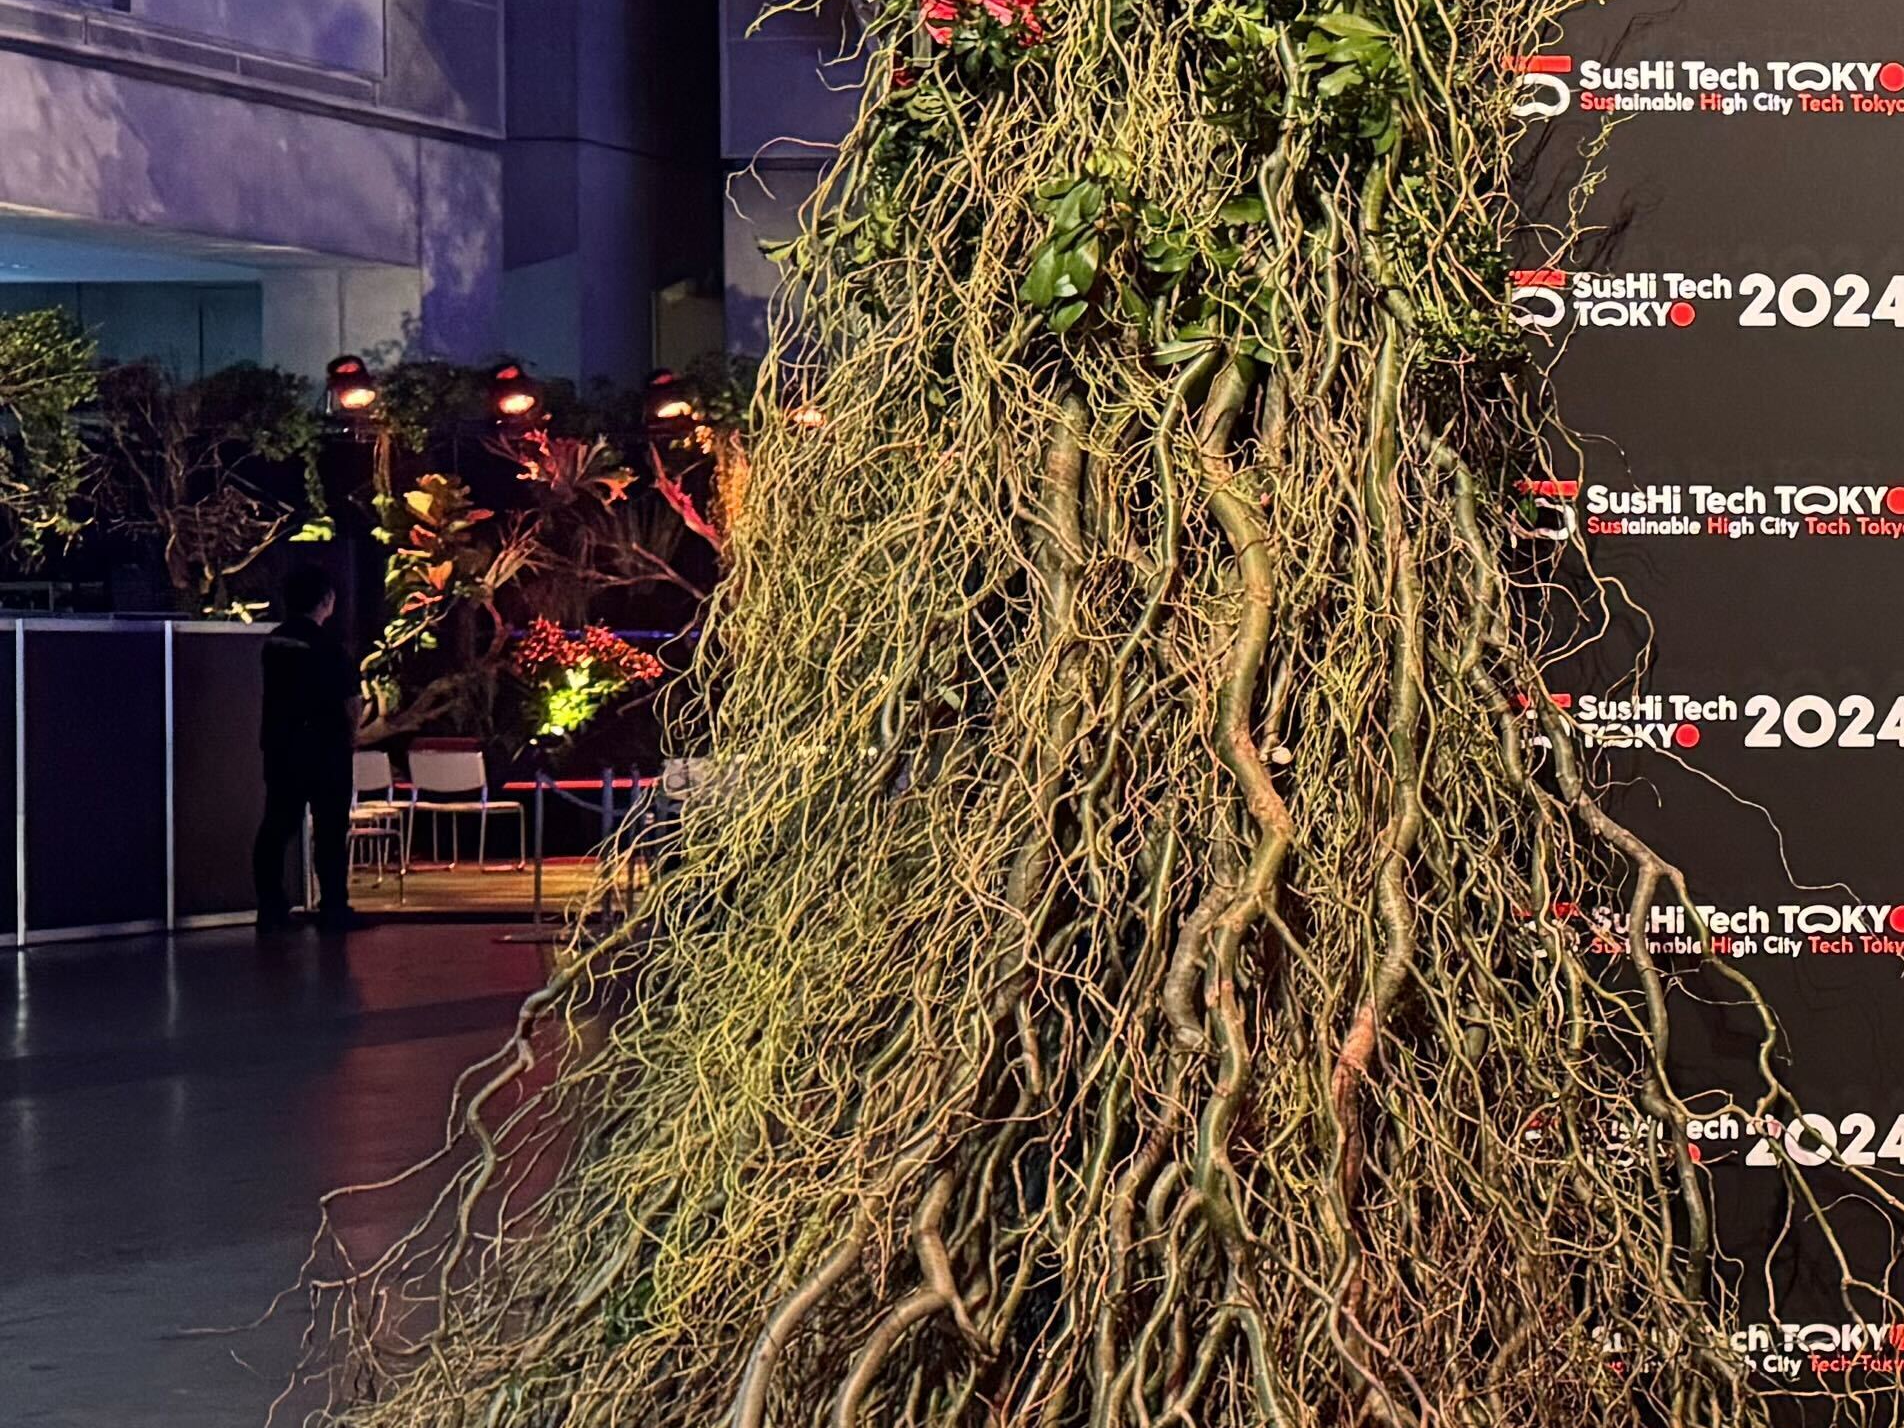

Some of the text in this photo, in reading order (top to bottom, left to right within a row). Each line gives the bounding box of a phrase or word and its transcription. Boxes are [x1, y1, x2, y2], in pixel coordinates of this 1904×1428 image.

[1572, 273, 1732, 299] SusHi Tech
[1574, 302, 1695, 327] TOKYO
